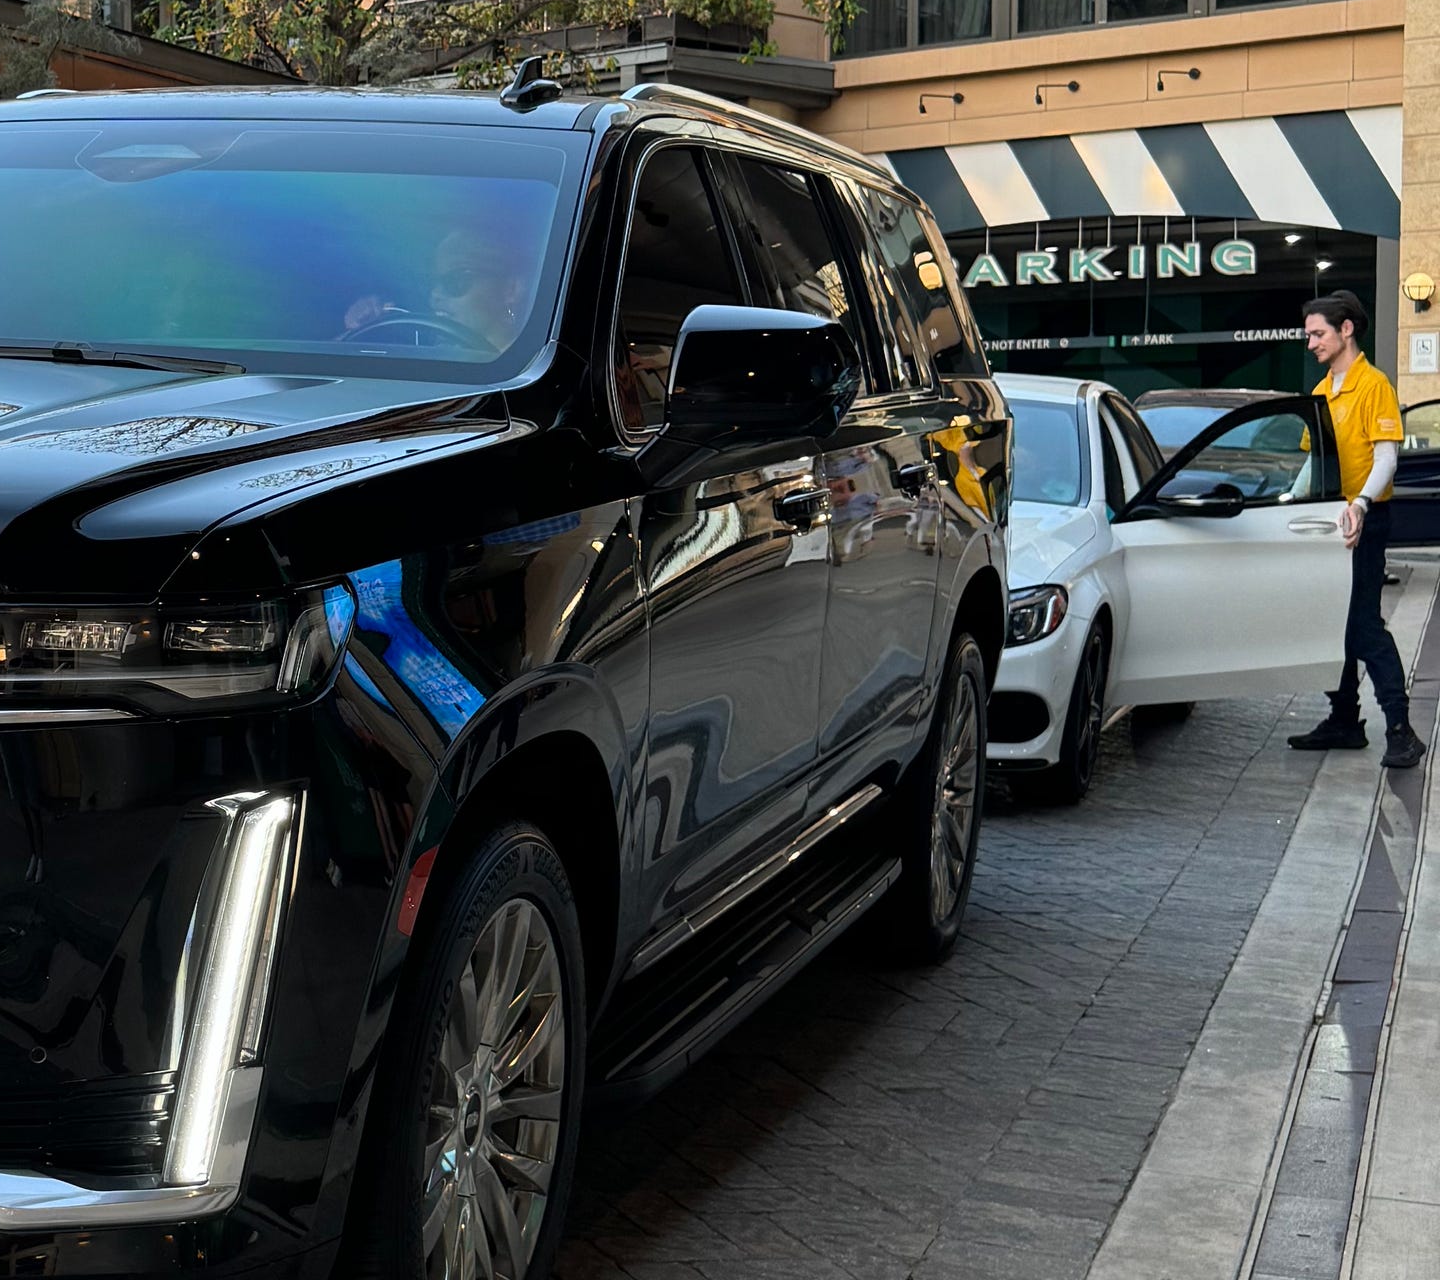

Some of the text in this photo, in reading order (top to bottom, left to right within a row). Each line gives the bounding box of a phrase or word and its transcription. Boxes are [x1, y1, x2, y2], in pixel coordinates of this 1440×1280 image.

[953, 238, 1256, 288] ARKING
[1144, 333, 1173, 345] PARK
[1233, 327, 1302, 342] CLEARANCE
[991, 339, 1014, 351] NOT
[1016, 338, 1050, 350] ENTER
